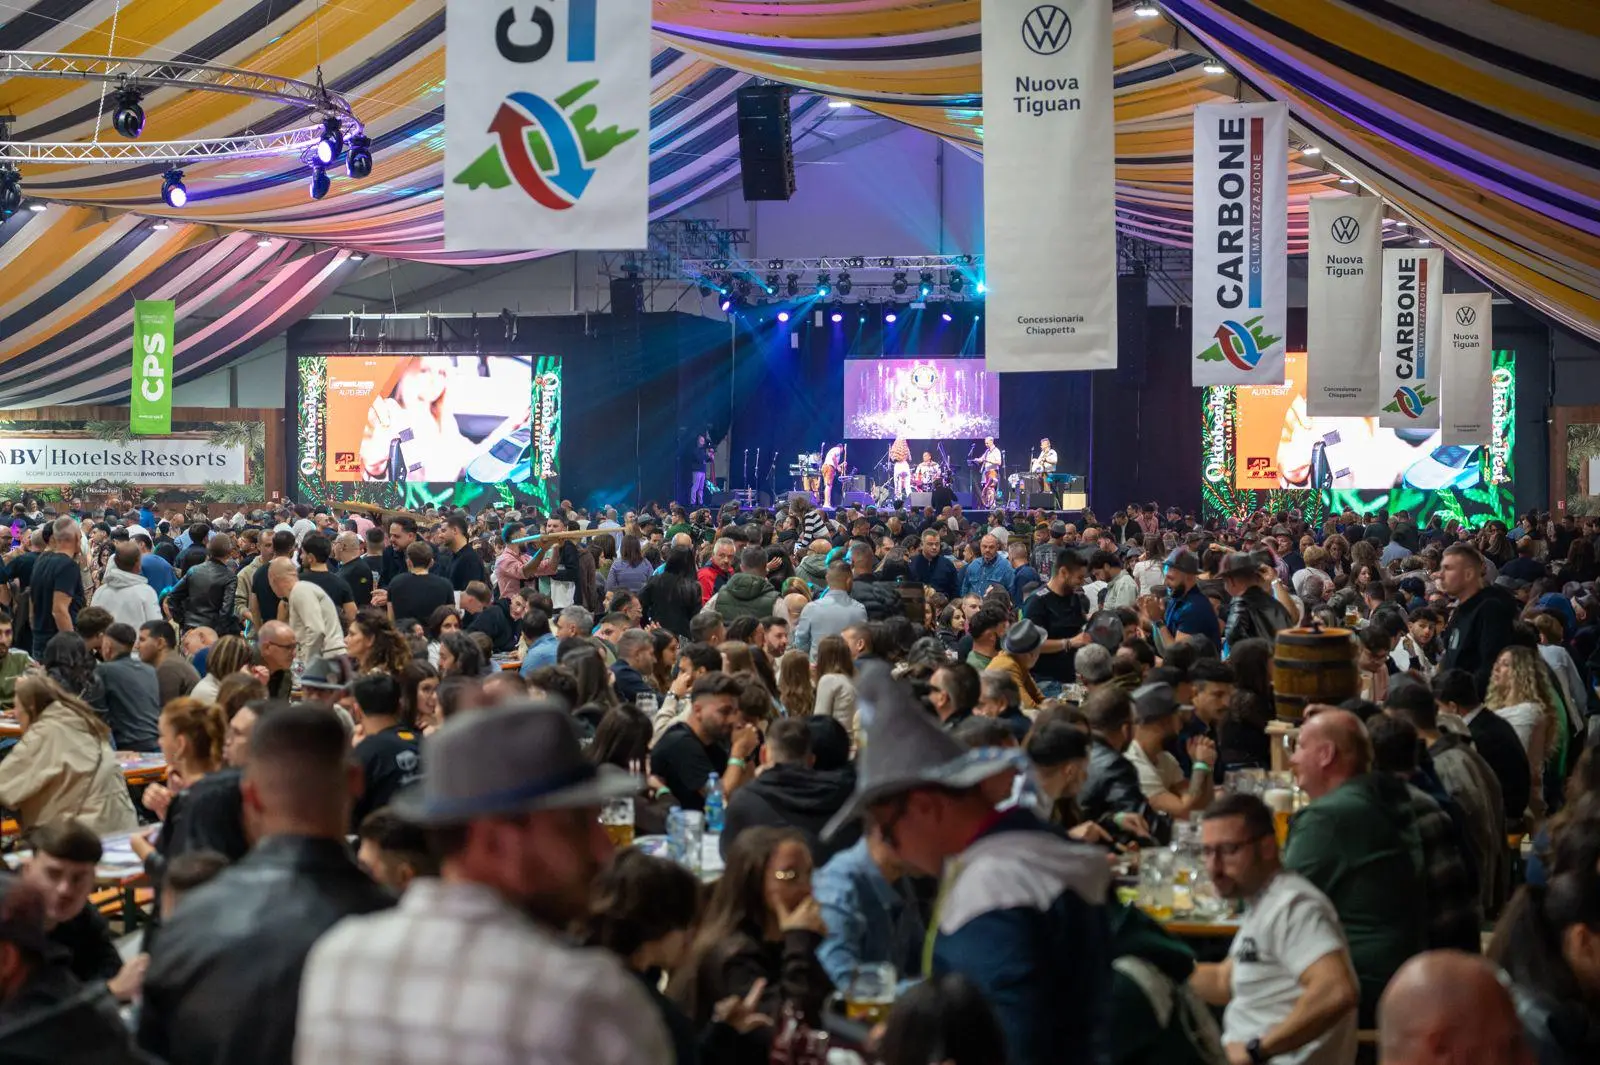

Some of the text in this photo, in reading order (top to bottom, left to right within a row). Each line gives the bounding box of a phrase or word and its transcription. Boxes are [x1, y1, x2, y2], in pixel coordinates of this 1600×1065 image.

[1015, 76, 1079, 93] Nuova
[1013, 97, 1081, 117] Tiguan
[1216, 117, 1245, 309] CARBONE
[1251, 154, 1262, 274] CLIMATIZZAZIONE
[1327, 255, 1363, 264] Nuova
[1325, 266, 1364, 278] Tiguan
[1017, 315, 1084, 324] Concessionaria
[1395, 258, 1416, 380] CARBONE
[1418, 281, 1426, 358] CLIMATIZZAZIONE
[1026, 326, 1075, 335] Chiappetta
[1453, 341, 1480, 350] Tiguan
[141, 333, 166, 402] CPS
[10, 449, 43, 465] BV
